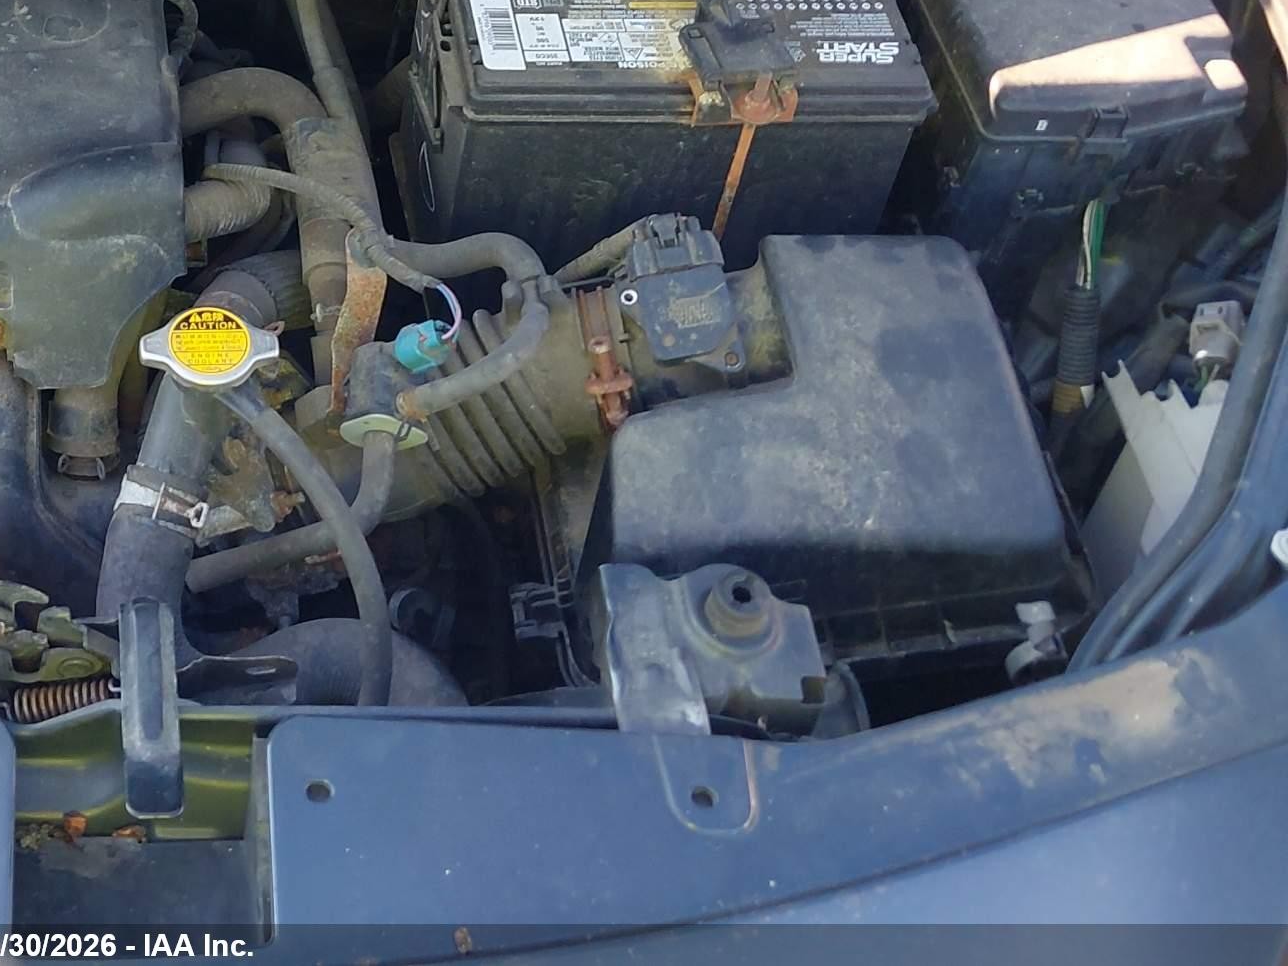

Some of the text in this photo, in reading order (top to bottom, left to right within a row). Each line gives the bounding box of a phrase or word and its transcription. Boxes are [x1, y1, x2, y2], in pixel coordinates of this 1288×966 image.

[817, 41, 899, 54] START
[818, 52, 894, 65] SUPER
[617, 60, 665, 69] POISON
[179, 321, 237, 330] CAUTION
